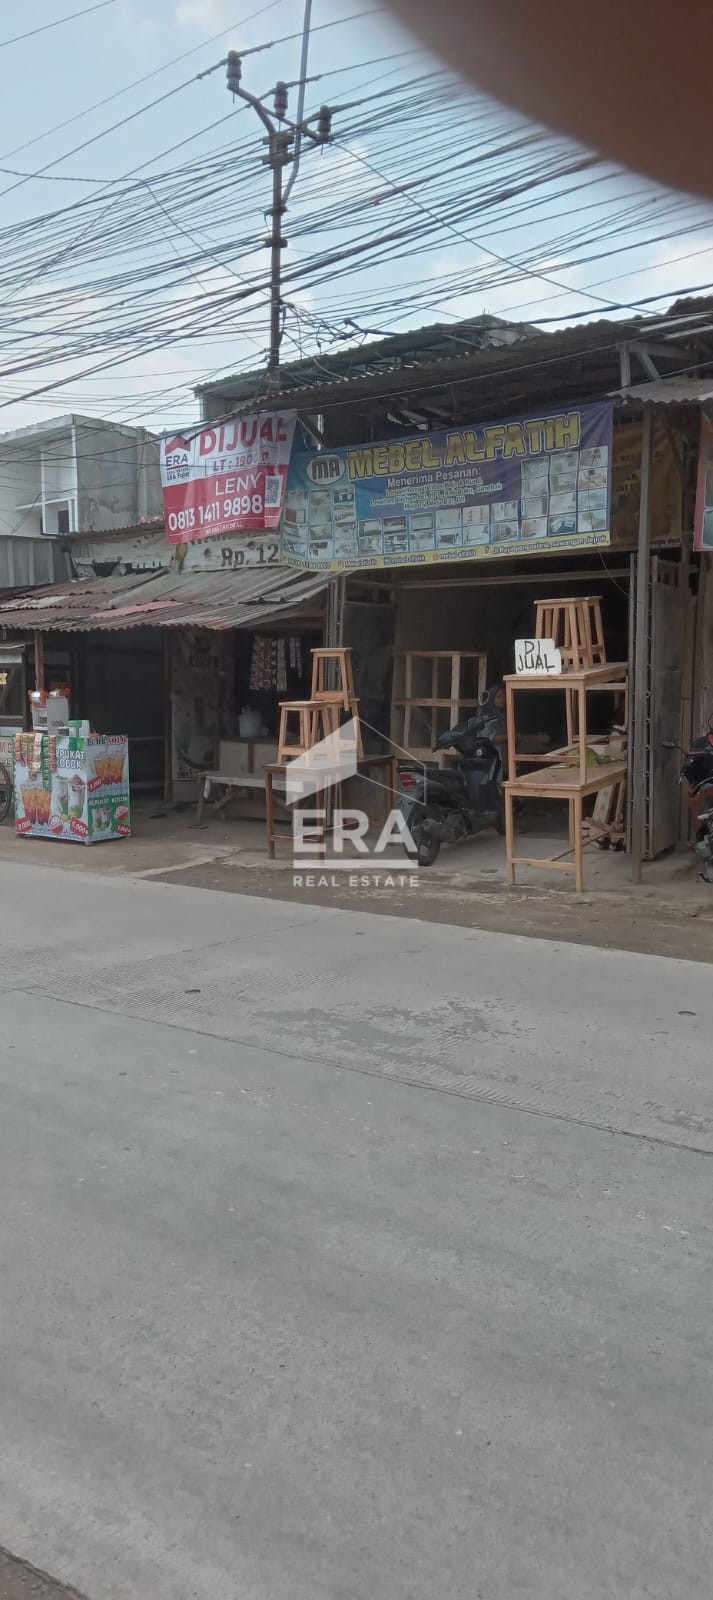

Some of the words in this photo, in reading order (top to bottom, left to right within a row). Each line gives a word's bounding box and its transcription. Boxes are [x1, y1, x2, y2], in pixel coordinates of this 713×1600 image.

[200, 416, 288, 457] DIJUAL
[349, 439, 442, 481] MEBEL
[445, 411, 581, 468] ALFATIH
[165, 454, 189, 467] ERA
[213, 459, 226, 472] LT
[311, 460, 341, 481] MA
[215, 472, 263, 497] LENY
[387, 473, 434, 489] Menerima
[435, 466, 482, 482] Pesanan:
[168, 507, 195, 531] 0813
[198, 502, 220, 524] 1411
[223, 494, 263, 519] 9898
[524, 640, 541, 655] DI
[517, 653, 556, 672] JUAL
